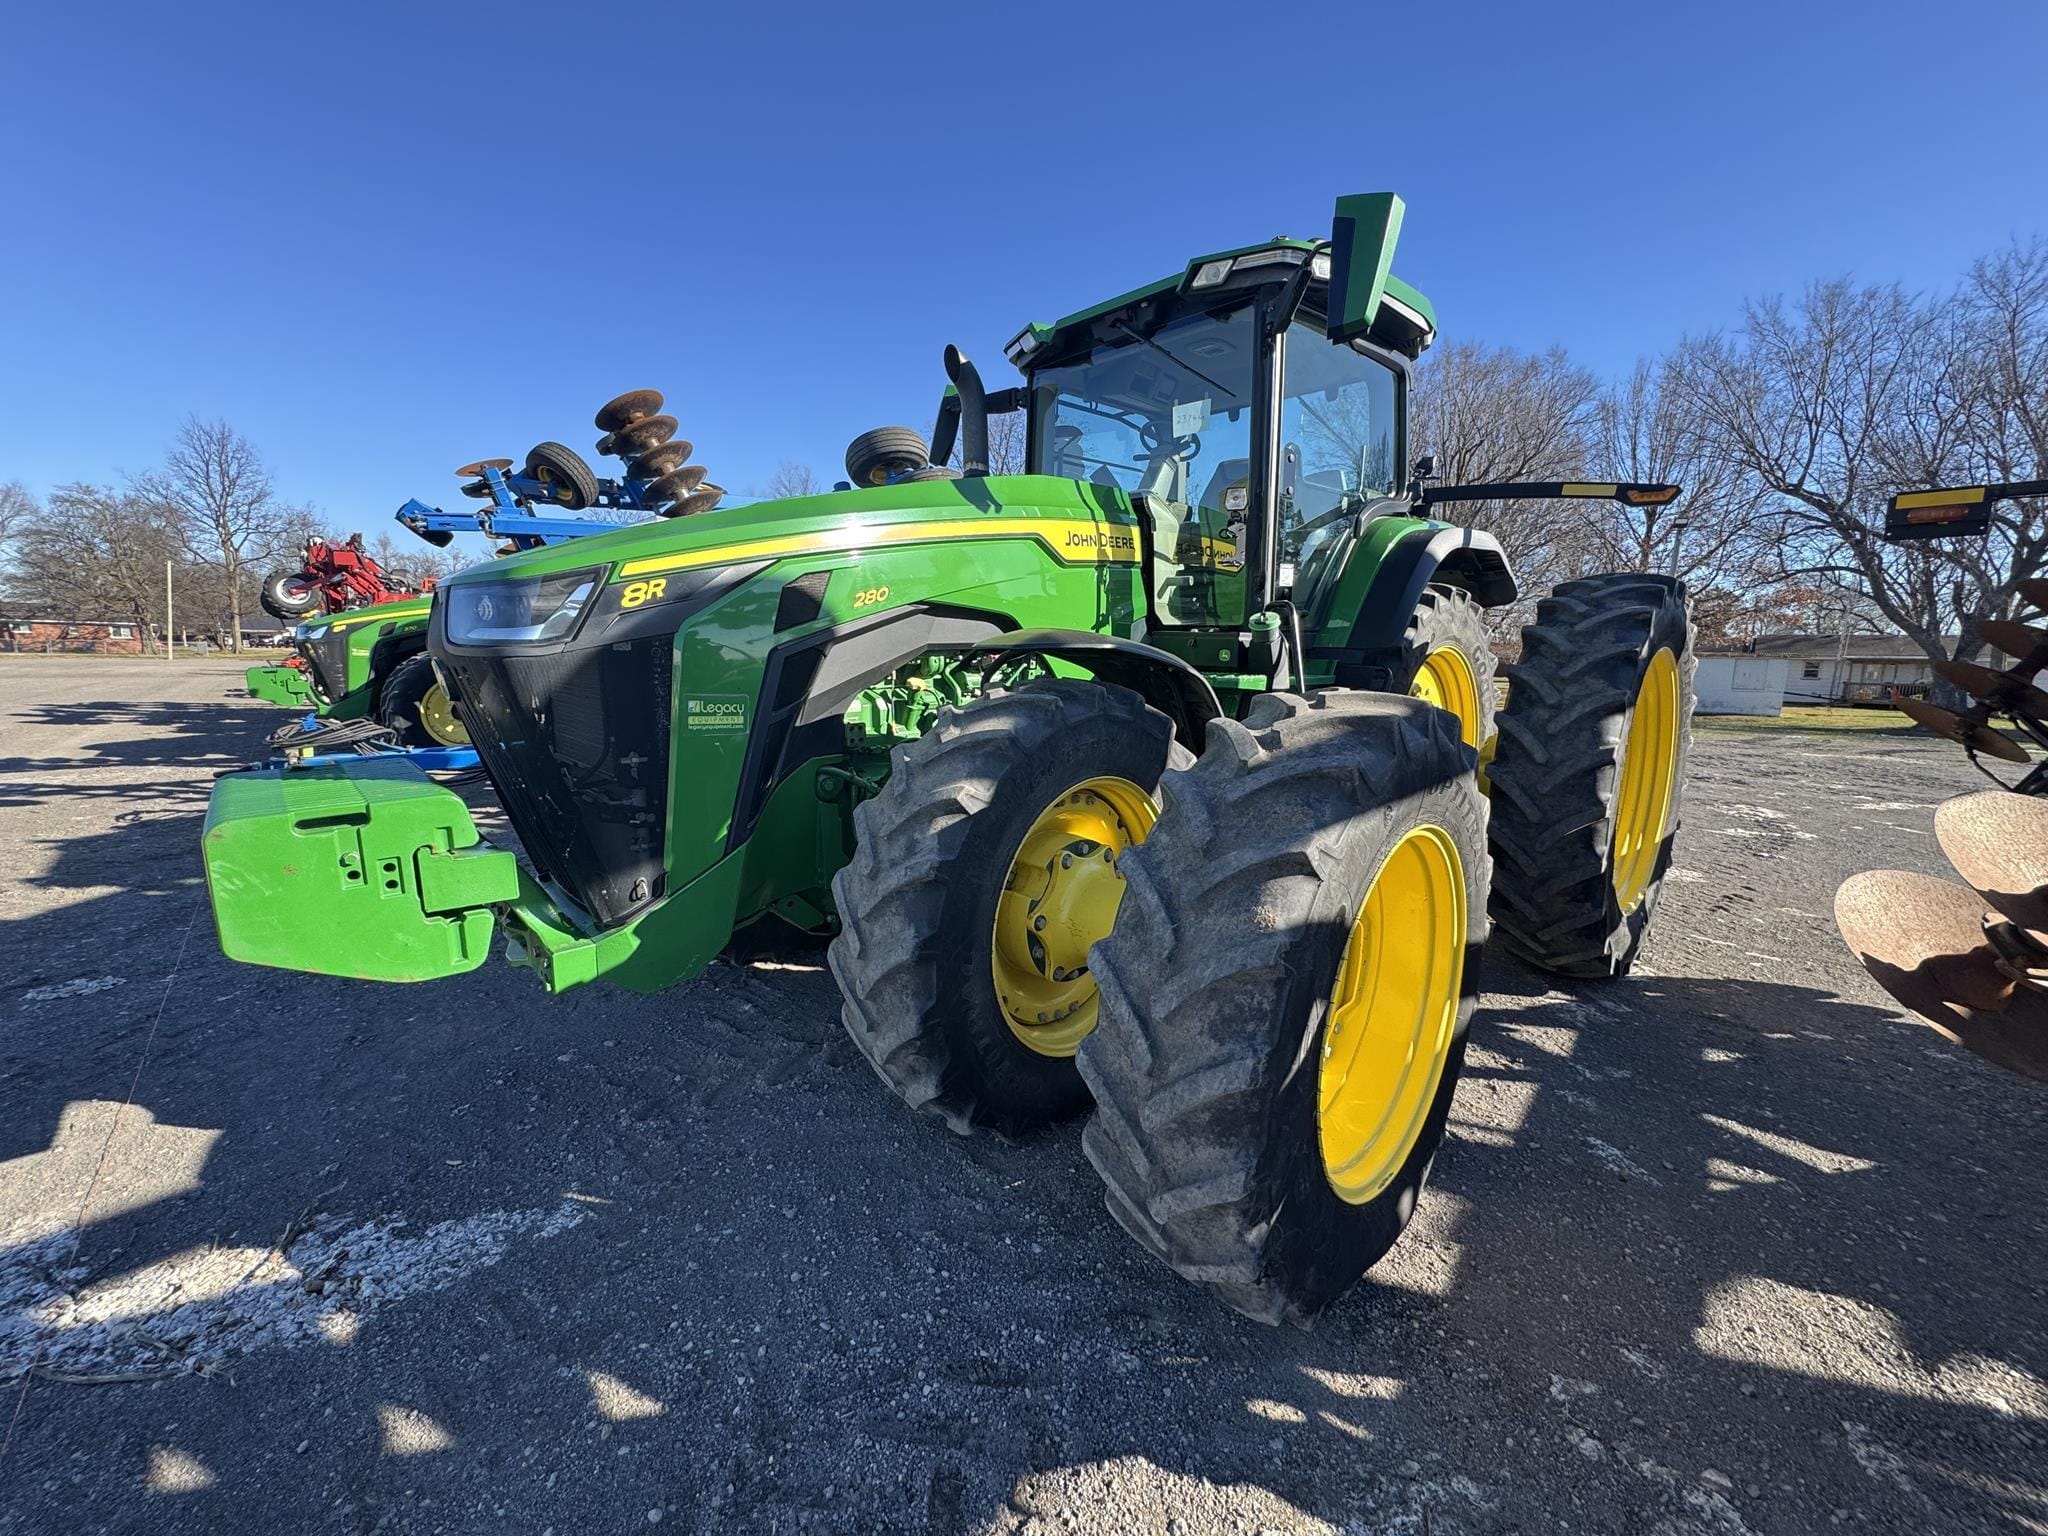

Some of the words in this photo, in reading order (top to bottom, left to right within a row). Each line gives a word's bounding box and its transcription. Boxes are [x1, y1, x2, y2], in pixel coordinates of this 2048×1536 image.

[1065, 530, 1098, 547] JOHN
[1100, 532, 1135, 549] DEERE
[621, 578, 667, 608] 8R
[853, 586, 889, 608] 280
[701, 700, 745, 716] Legacy
